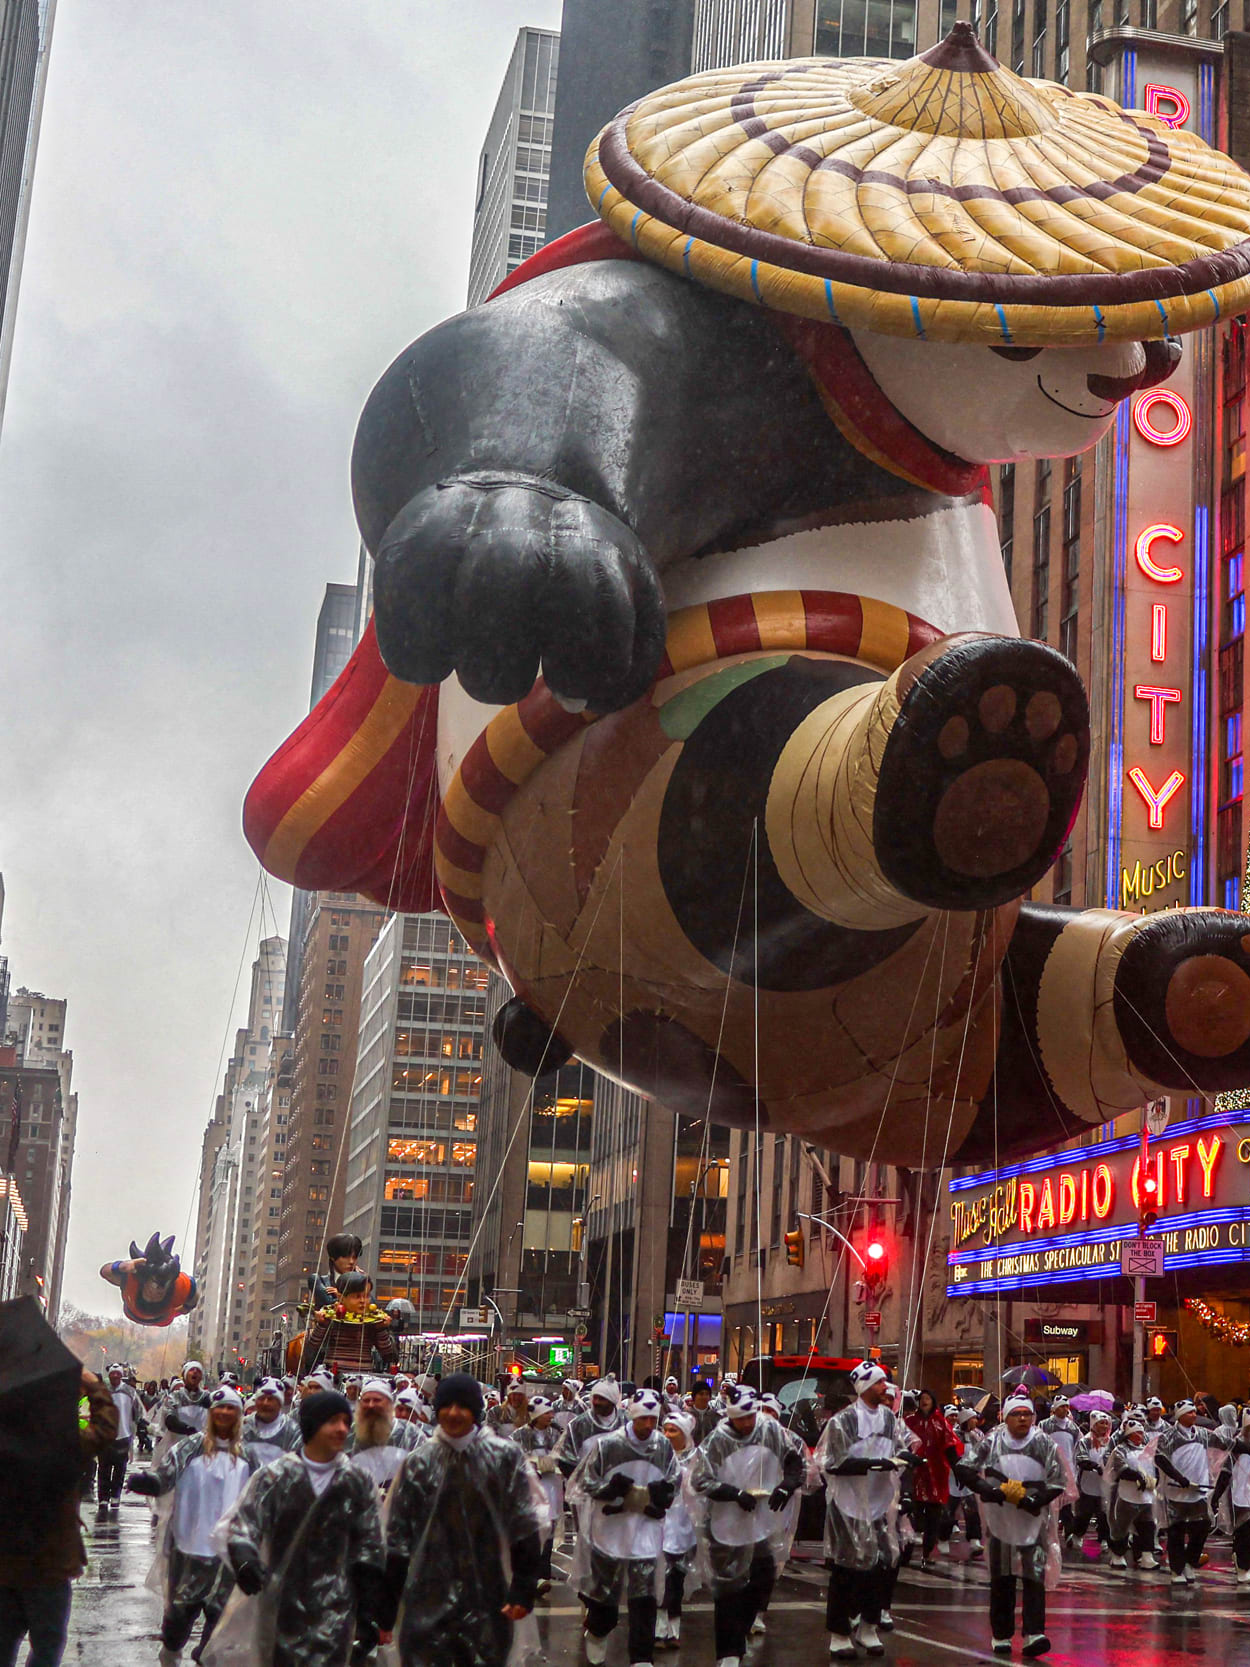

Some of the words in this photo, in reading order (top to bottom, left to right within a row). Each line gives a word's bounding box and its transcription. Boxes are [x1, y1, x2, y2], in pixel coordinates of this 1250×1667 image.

[1127, 523, 1186, 830] CITY
[983, 1176, 1018, 1246] Hall
[1019, 1163, 1113, 1234] RADIO
[1123, 1241, 1142, 1250] DON'T
[1142, 1241, 1162, 1250] BLOCK
[1161, 1230, 1179, 1253] THE
[1185, 1224, 1219, 1251] RADIO
[980, 1260, 993, 1278] THE
[997, 1252, 1040, 1276] CHRISTMAS
[1043, 1242, 1106, 1271] SPECTACULAR
[1043, 1325, 1079, 1337] Subway
[551, 1347, 570, 1363] TD
